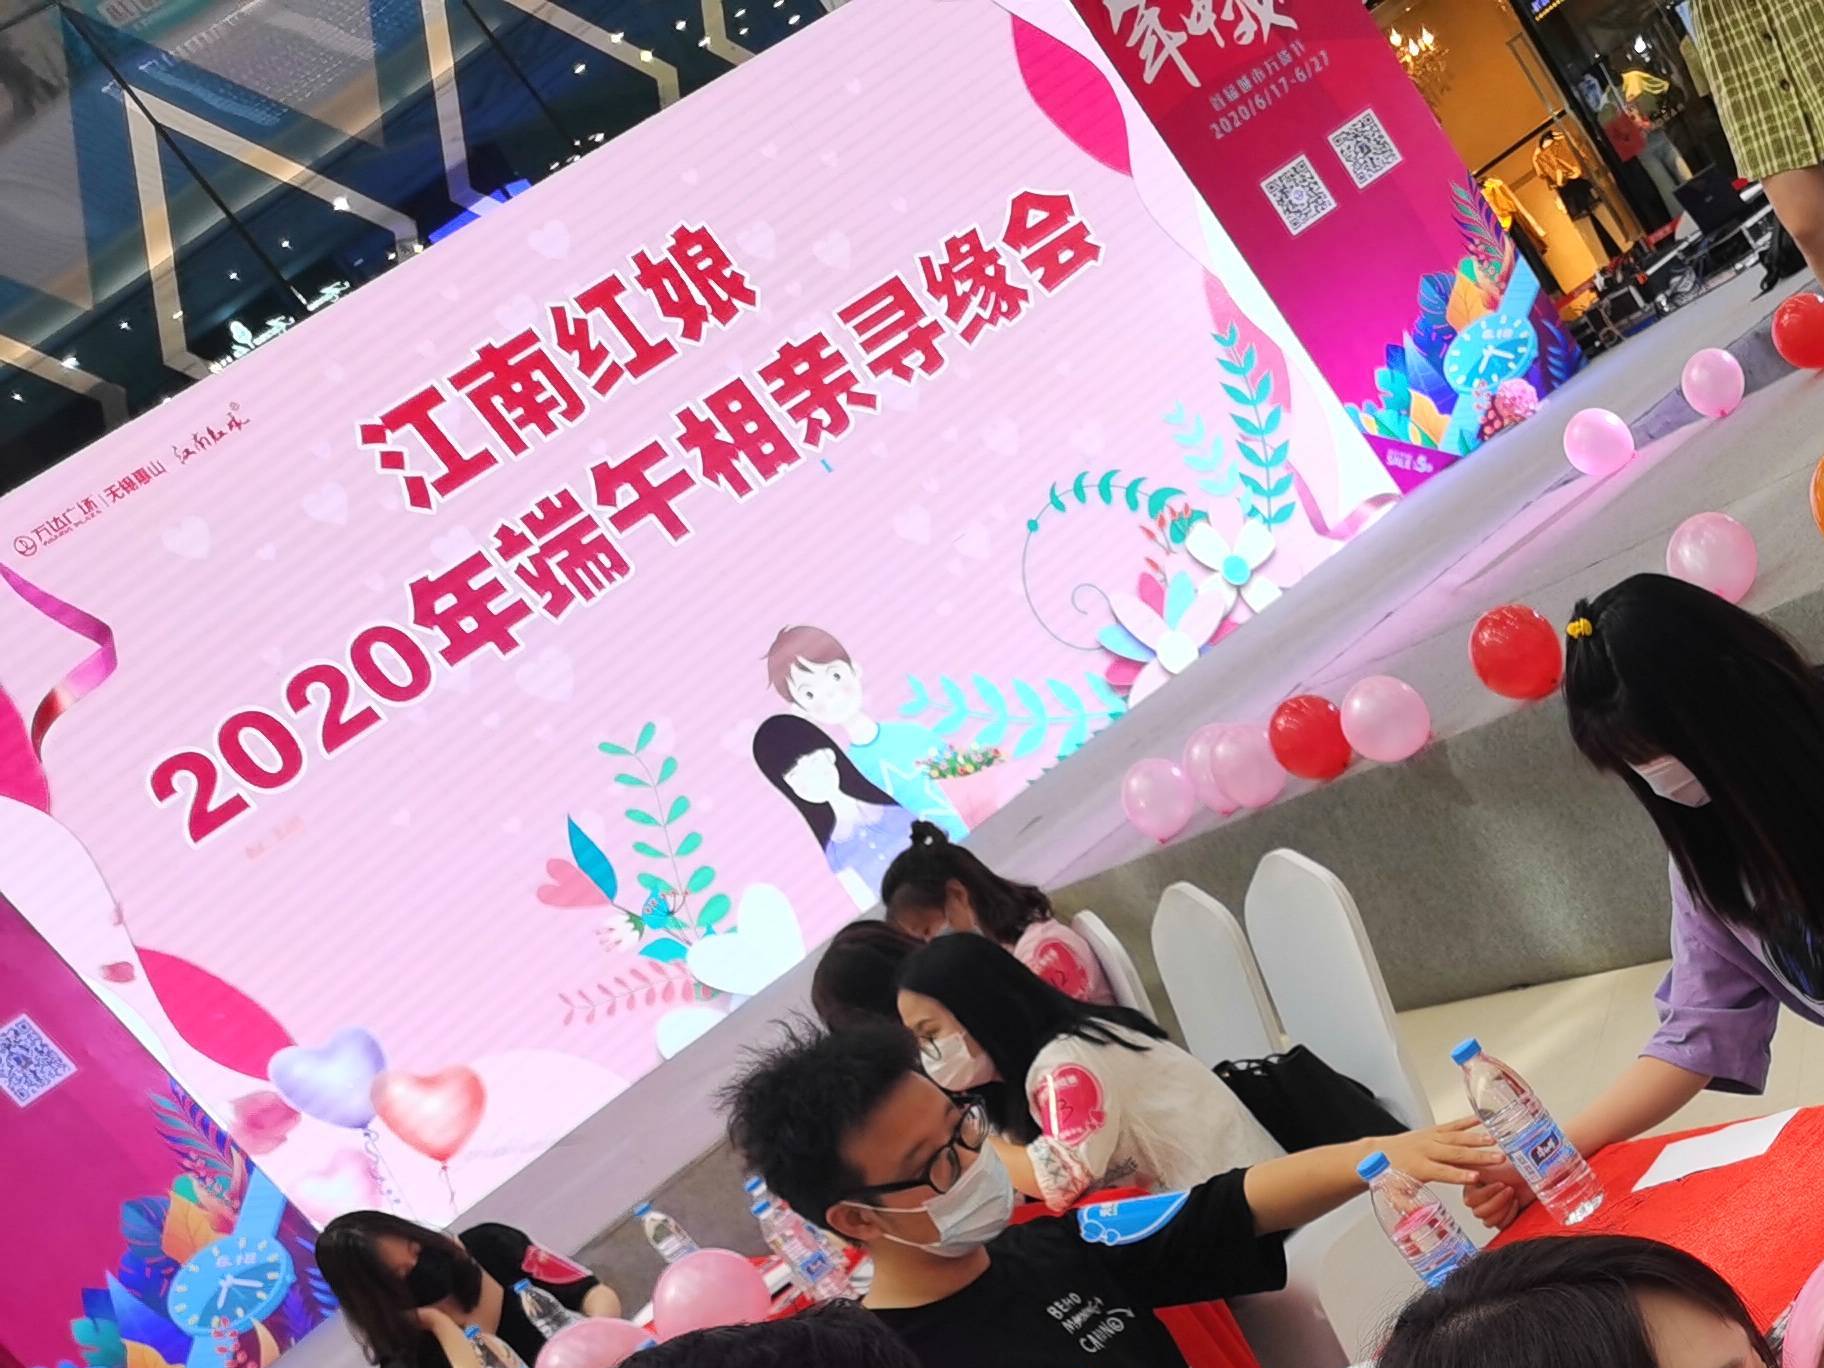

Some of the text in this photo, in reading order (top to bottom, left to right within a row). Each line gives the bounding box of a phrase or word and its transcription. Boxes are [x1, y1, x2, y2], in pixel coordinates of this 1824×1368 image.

[151, 191, 1099, 843] 2020年端午相亲寻缘会
[360, 225, 757, 508] 江南红娘
